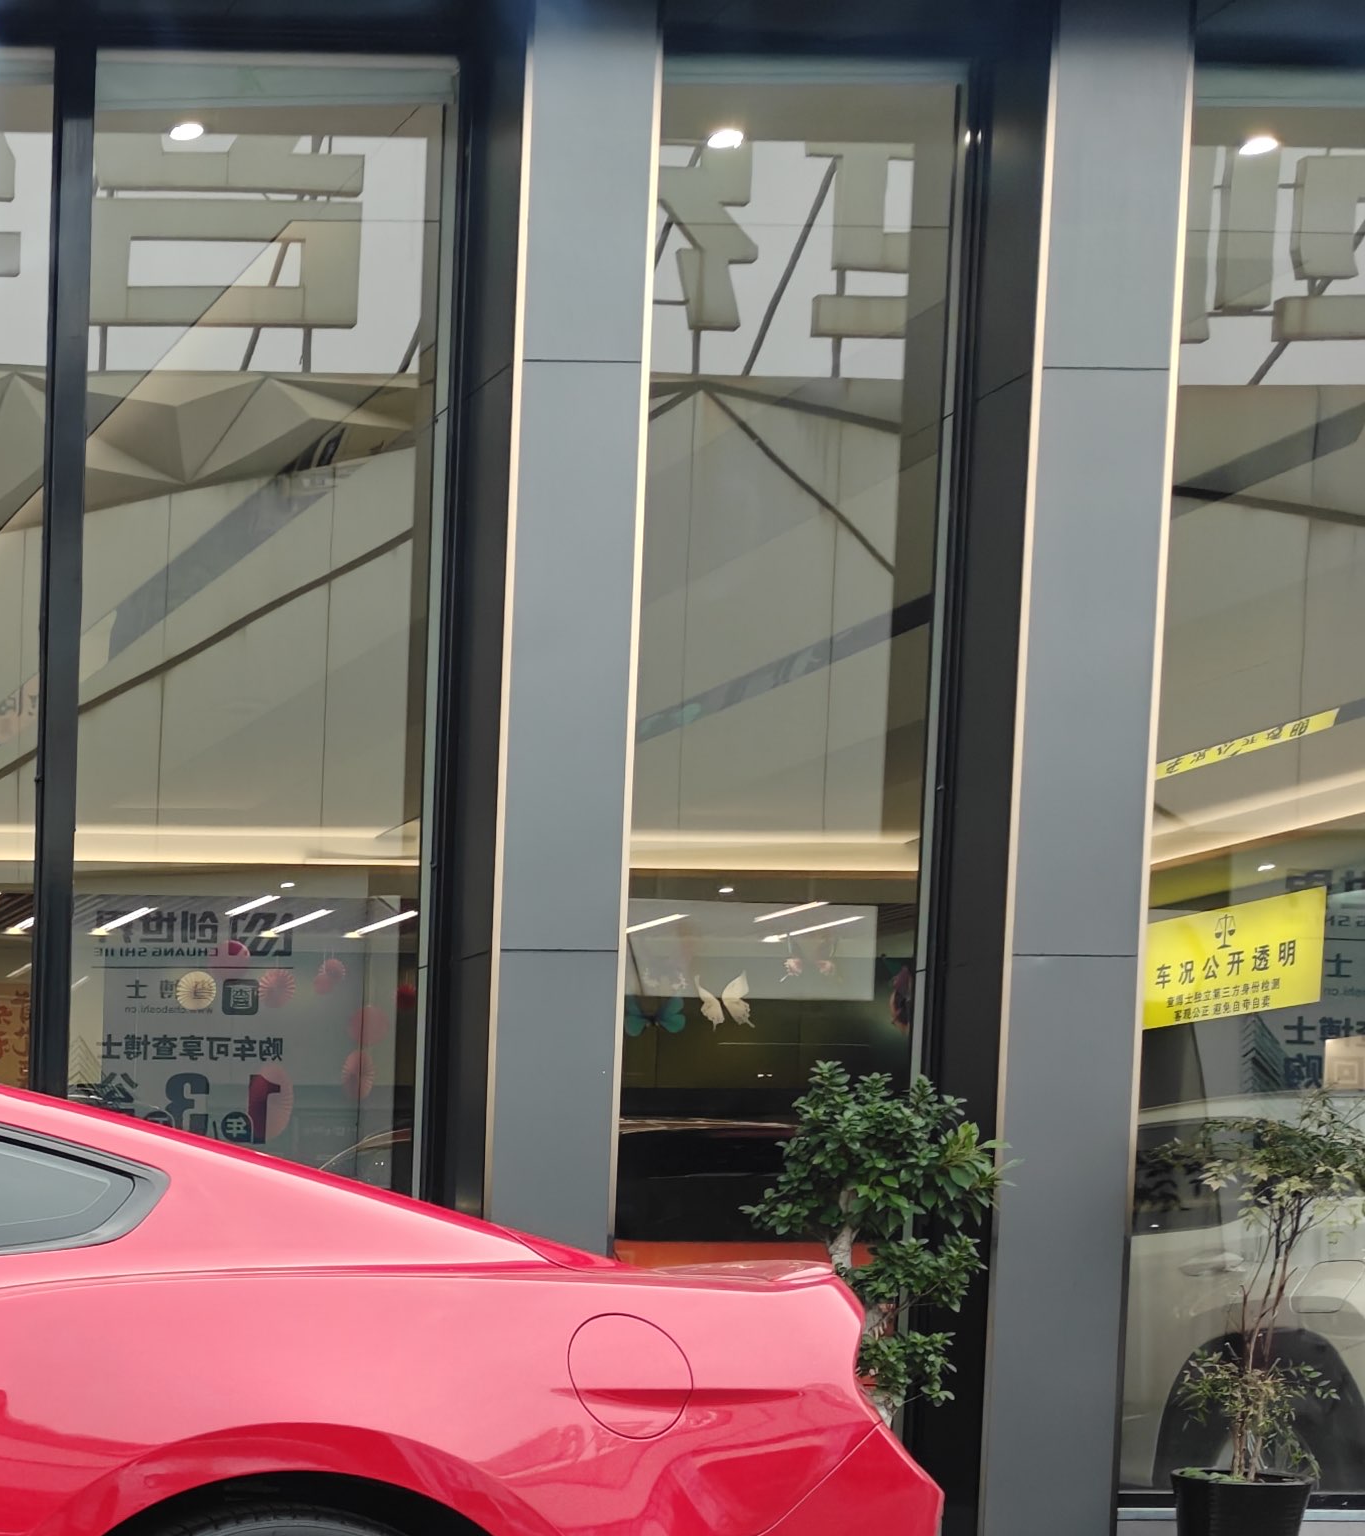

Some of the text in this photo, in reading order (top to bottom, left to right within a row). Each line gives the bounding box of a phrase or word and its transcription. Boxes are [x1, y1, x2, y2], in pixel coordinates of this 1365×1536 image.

[1155, 939, 1296, 989] 车况公开透明
